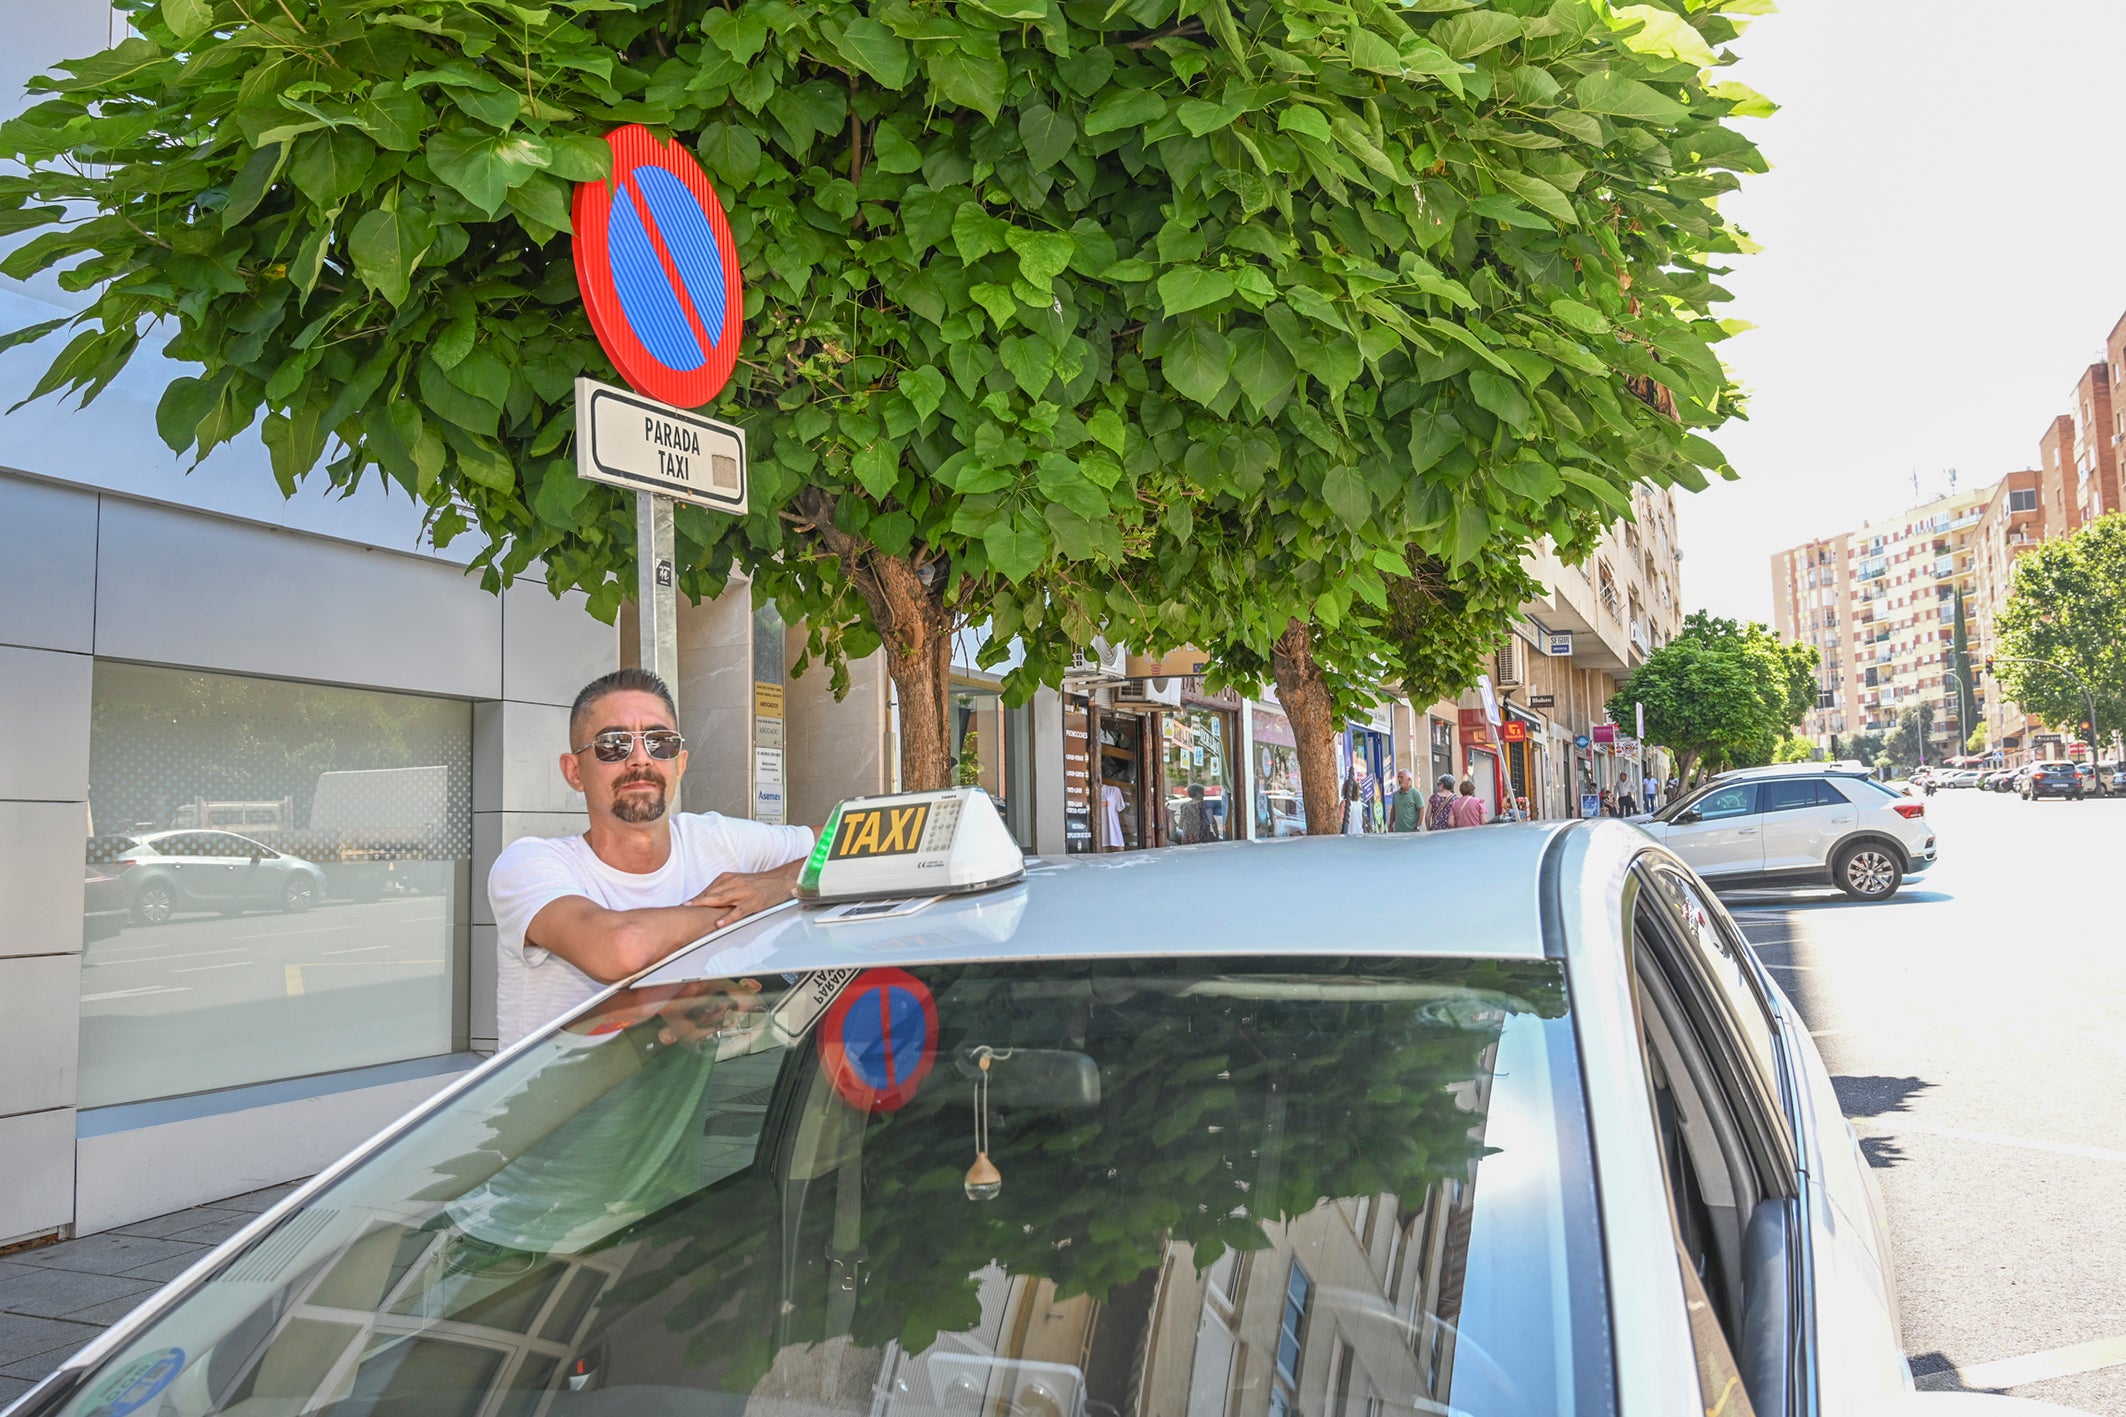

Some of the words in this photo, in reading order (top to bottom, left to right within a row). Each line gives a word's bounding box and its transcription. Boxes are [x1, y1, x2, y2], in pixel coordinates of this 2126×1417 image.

[645, 416, 700, 456] PARADA
[658, 450, 689, 481] TAXI
[839, 806, 927, 856] TAXI
